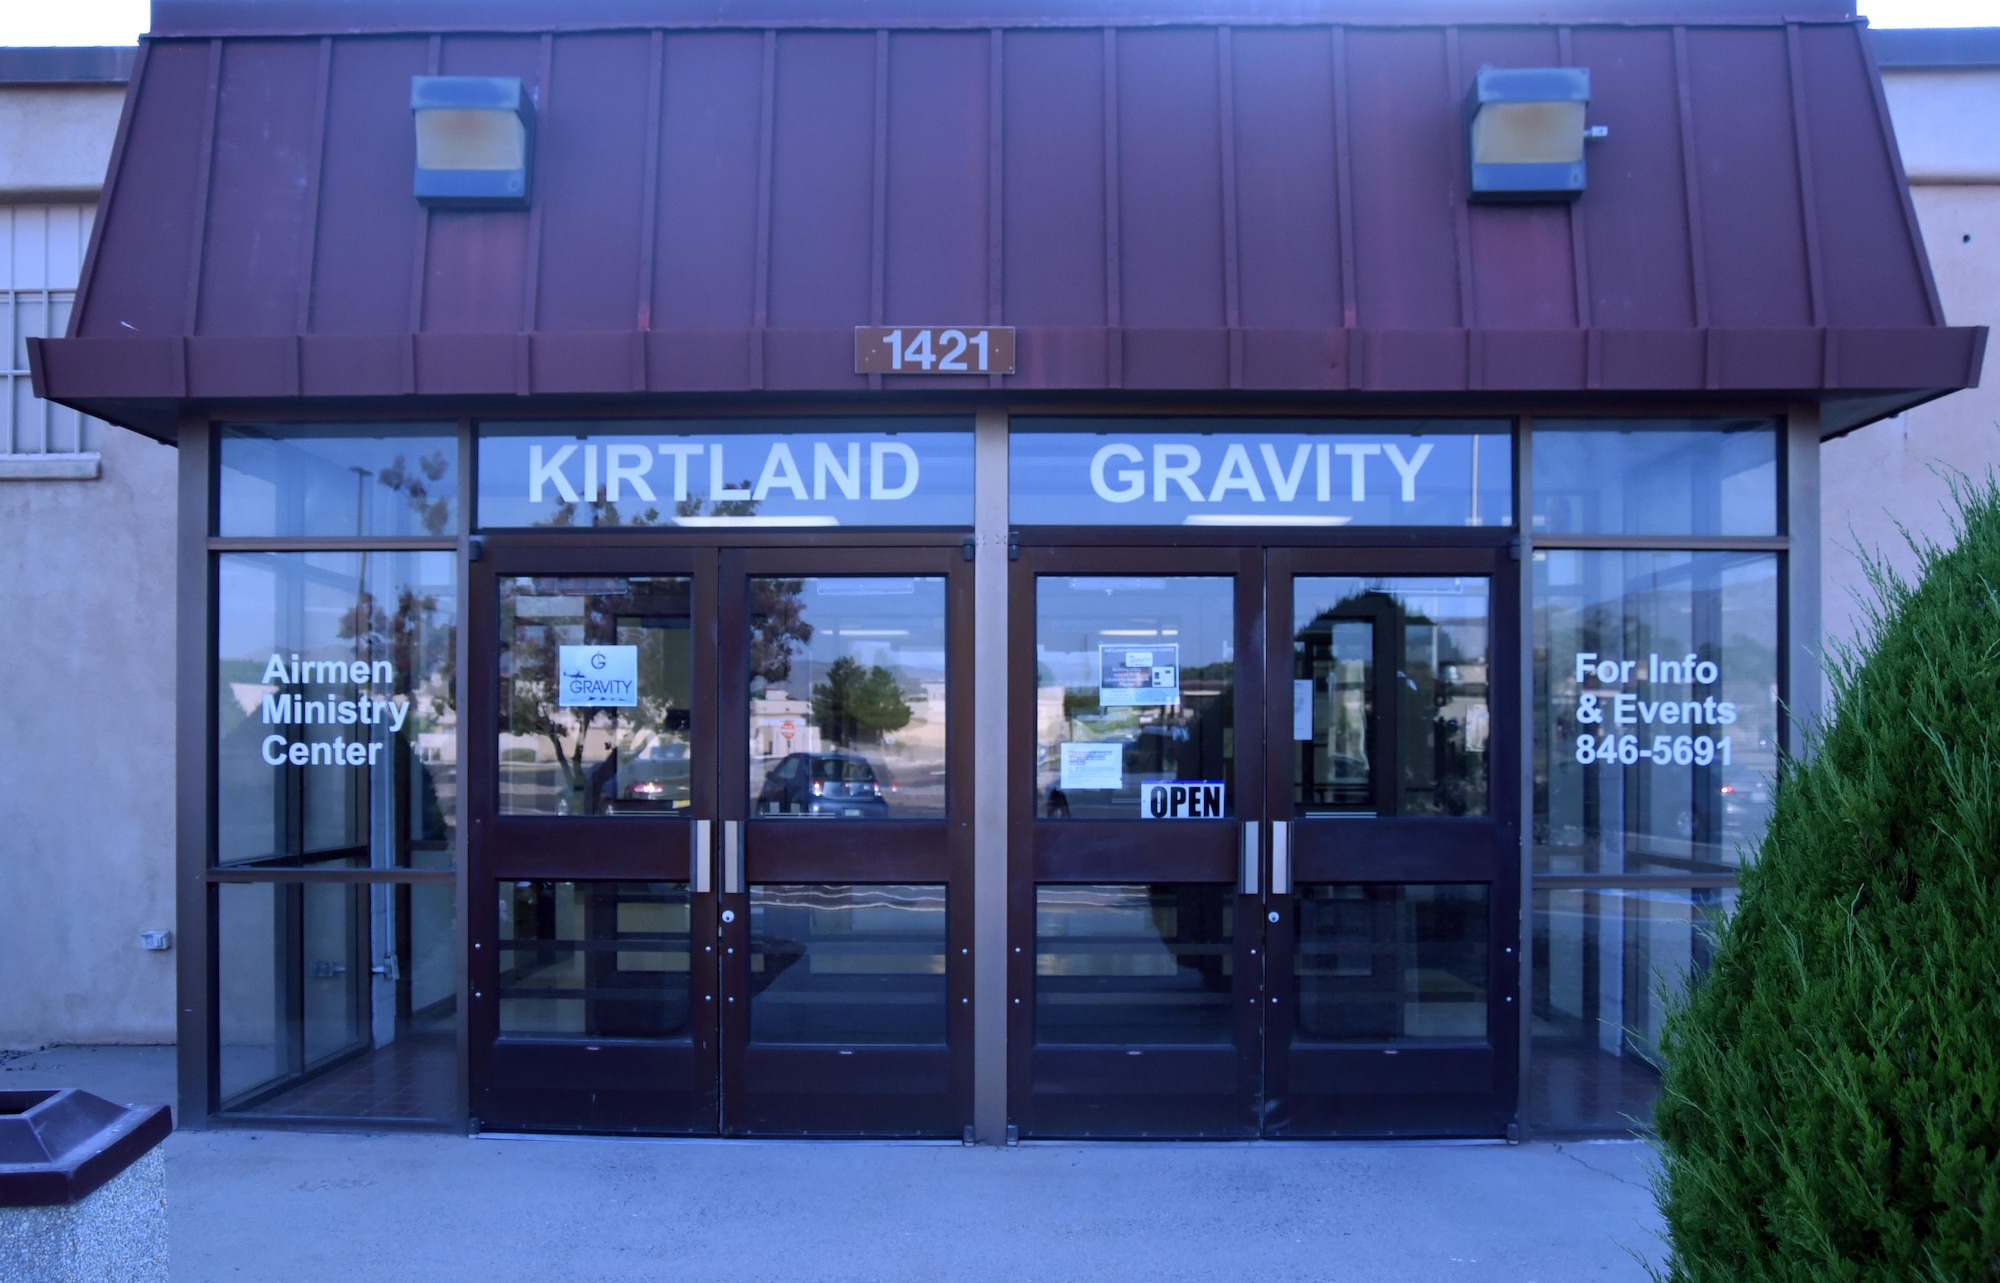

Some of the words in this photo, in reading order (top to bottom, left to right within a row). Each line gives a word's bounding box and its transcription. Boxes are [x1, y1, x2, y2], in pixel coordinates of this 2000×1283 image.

[882, 329, 988, 371] 1421
[529, 442, 920, 503] KIRTLAND
[1090, 443, 1435, 503] GRAVITY
[262, 653, 393, 684] Airmen
[1575, 652, 1635, 683] For
[1650, 653, 1718, 684] Info
[569, 679, 632, 694] GRAVITY
[262, 693, 410, 732] Ministry
[1576, 693, 1603, 724] &
[1614, 693, 1737, 725] Events
[262, 734, 383, 766] Center
[1575, 733, 1733, 766] 846-5691
[1150, 785, 1220, 818] OPEN
